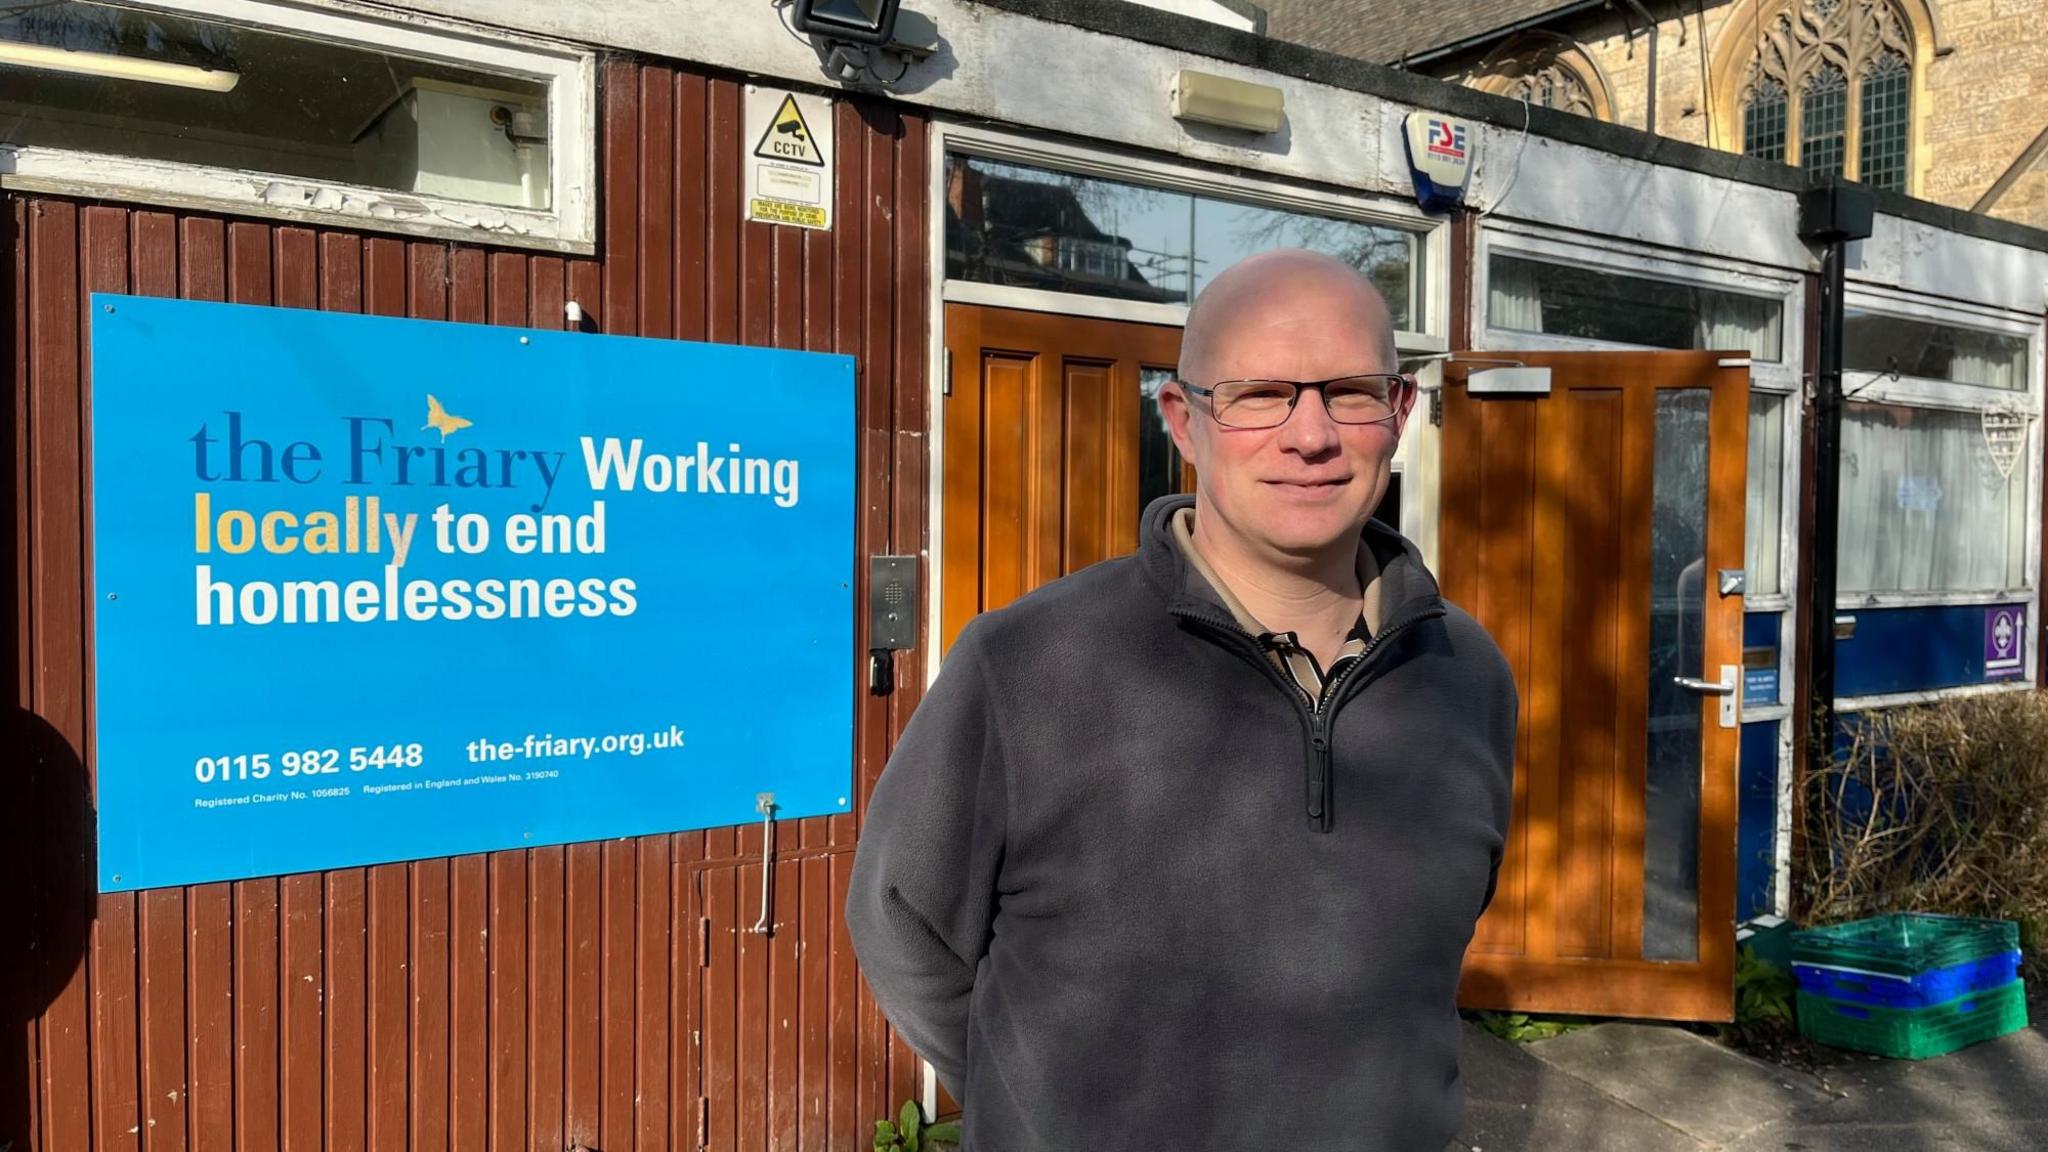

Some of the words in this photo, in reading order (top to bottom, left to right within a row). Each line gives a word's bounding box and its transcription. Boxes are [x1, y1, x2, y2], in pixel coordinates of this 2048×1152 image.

[774, 141, 805, 157] CCTV
[1428, 119, 1465, 150] FSE
[189, 411, 322, 484] the
[341, 416, 567, 513] Friary
[580, 436, 799, 507] Working
[195, 493, 418, 567] locally
[432, 503, 490, 553] to
[505, 500, 605, 554] end
[196, 564, 637, 625] homelessness
[195, 753, 271, 783] 0115
[281, 749, 340, 777] 982
[350, 743, 423, 772] 5448
[466, 725, 685, 763] the-friary.org.uk
[195, 795, 249, 808] Registered
[252, 792, 289, 804] Charity
[291, 791, 308, 800] No.
[312, 786, 350, 798] 1056825
[363, 782, 412, 795] Registered
[414, 781, 423, 790] in
[425, 778, 461, 789] England
[463, 776, 480, 785] and
[481, 774, 507, 784] Wales
[508, 773, 522, 781] No.
[525, 770, 559, 781] 3190740
